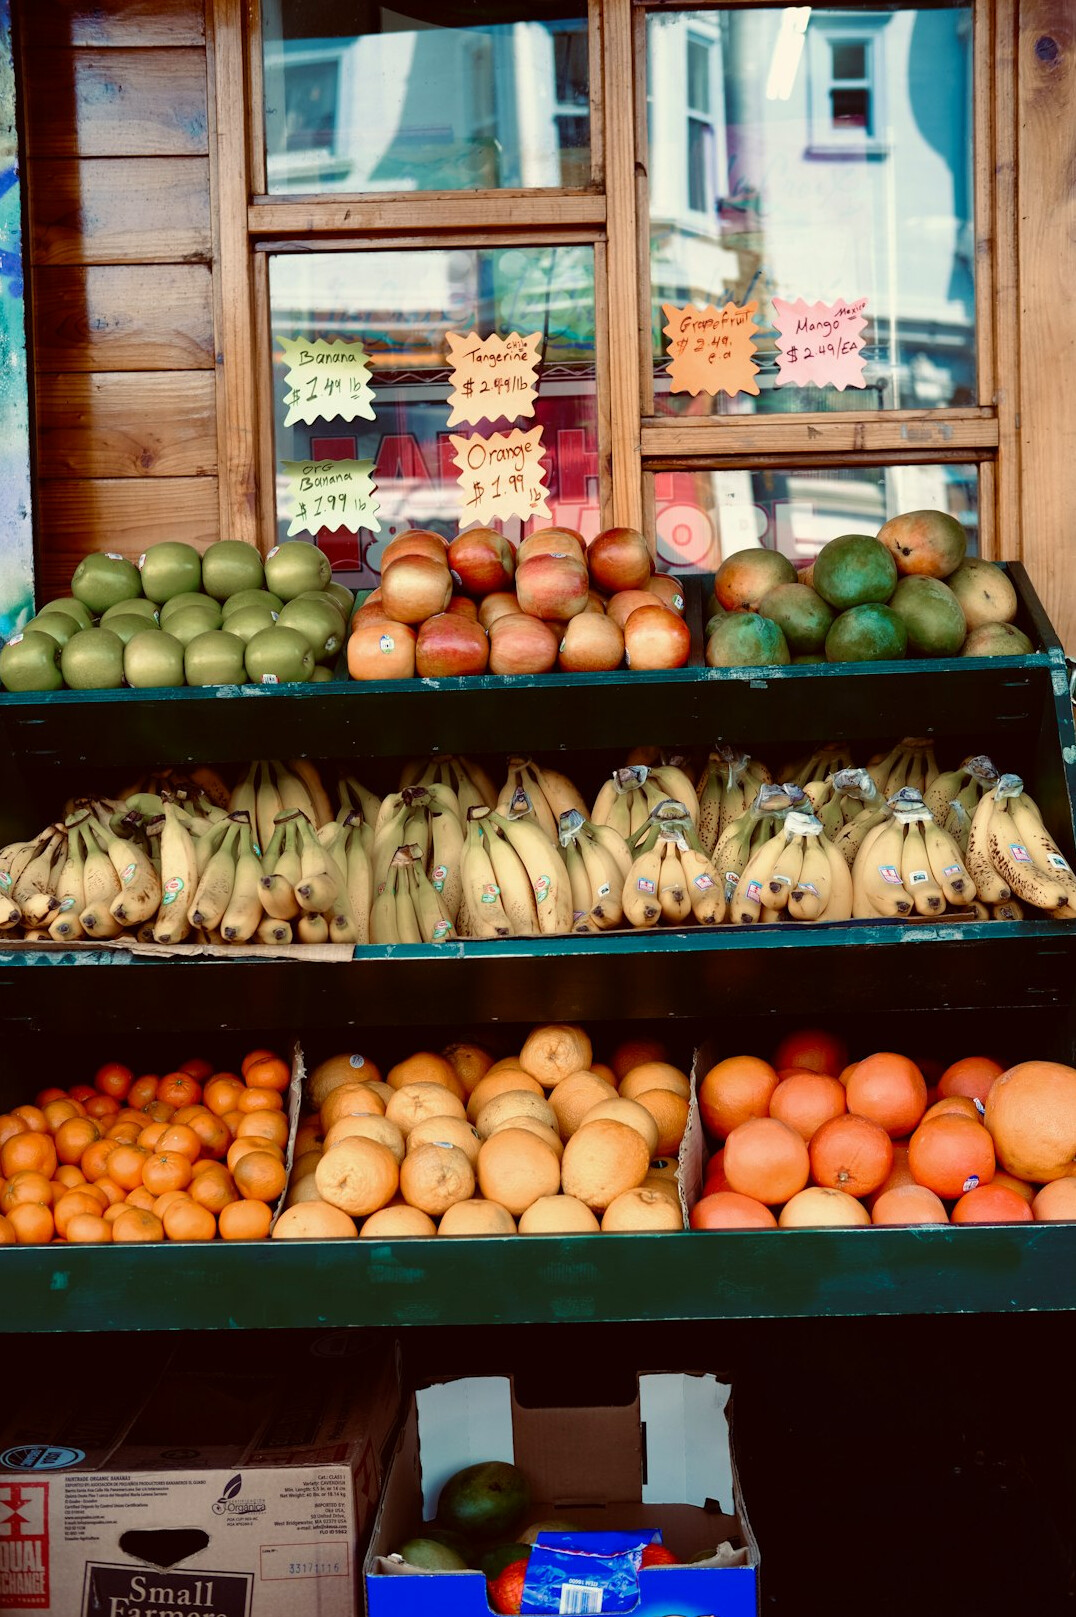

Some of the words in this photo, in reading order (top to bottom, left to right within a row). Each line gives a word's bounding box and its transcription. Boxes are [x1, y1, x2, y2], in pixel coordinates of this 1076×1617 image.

[834, 303, 866, 317] Mexico
[796, 317, 839, 338] Mango
[299, 351, 356, 366] Banana
[462, 347, 528, 368] Tangerine
[467, 442, 532, 471] Orange
[300, 473, 352, 491] Banana
[289, 1563, 339, 1574] 33171116
[130, 1576, 214, 1606] Small
[109, 1596, 227, 1617] Farm
